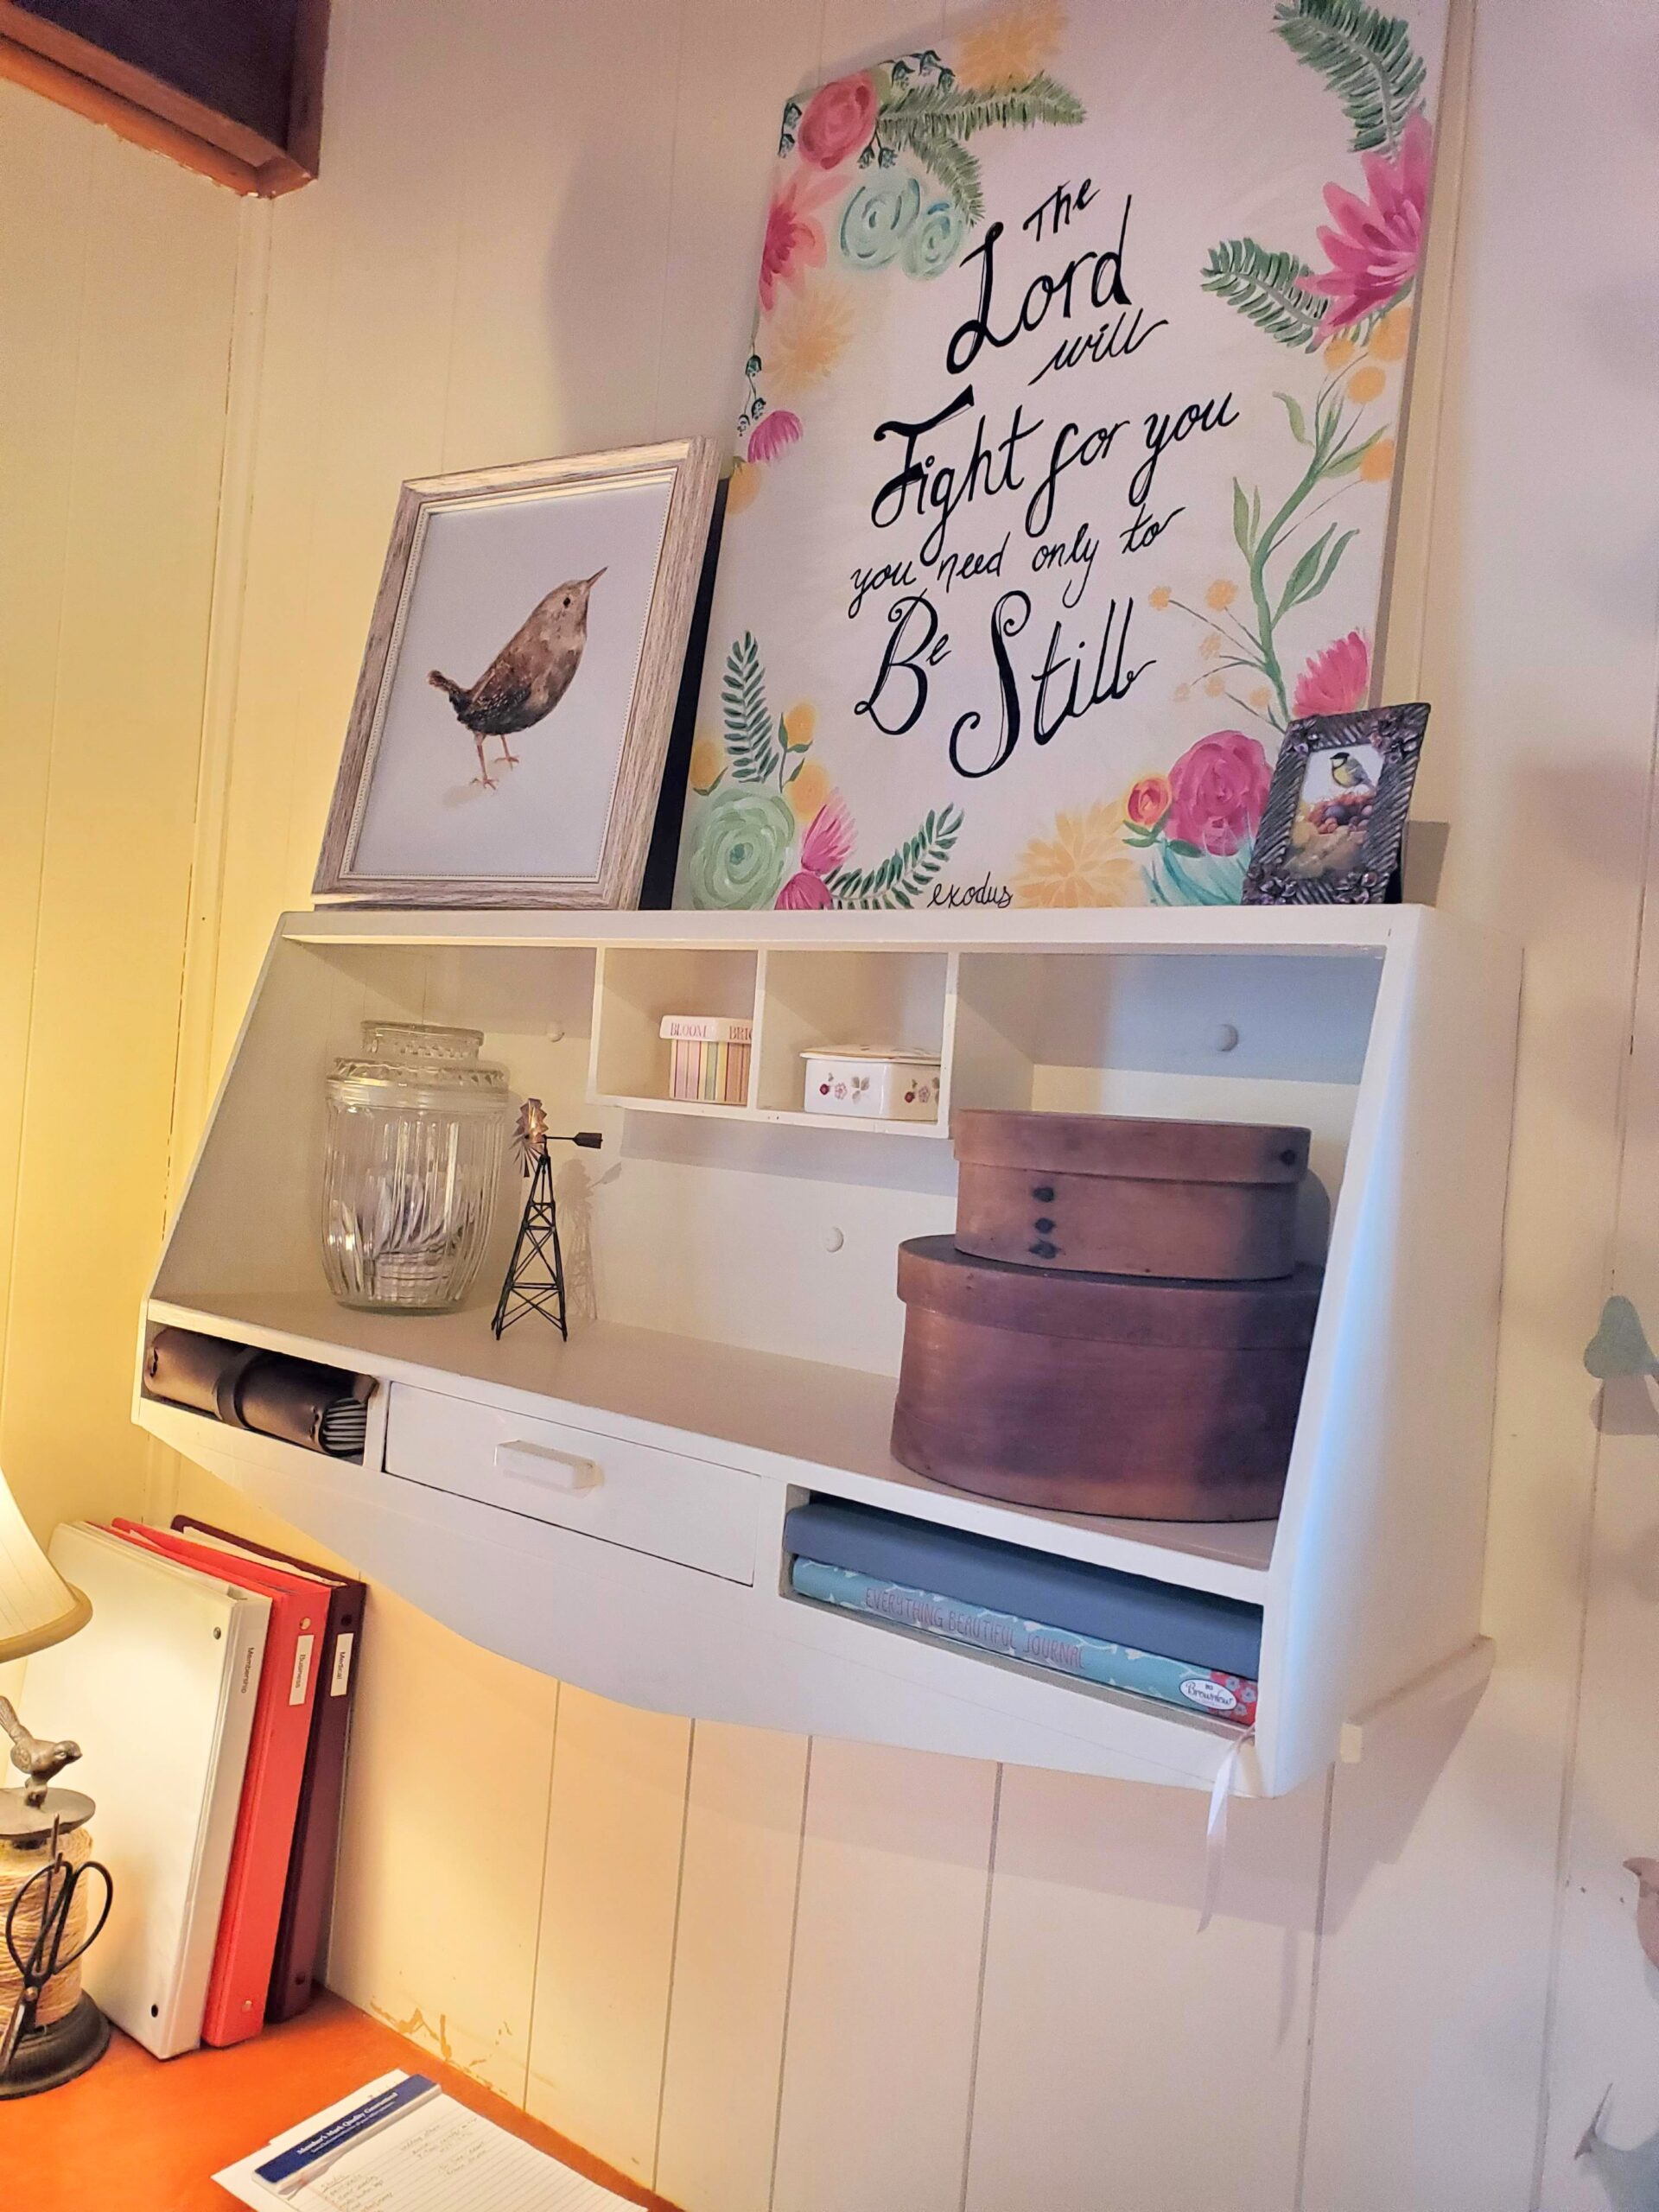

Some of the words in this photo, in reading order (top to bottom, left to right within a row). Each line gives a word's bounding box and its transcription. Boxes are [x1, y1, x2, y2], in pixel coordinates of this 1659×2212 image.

[1022, 178, 1101, 242] The
[946, 194, 1132, 374] Lord
[1027, 308, 1169, 386] will
[870, 384, 1044, 567] Fight
[1025, 422, 1130, 537] for
[1128, 391, 1240, 507] you
[847, 562, 917, 619] you
[936, 531, 1011, 594] need
[1031, 523, 1100, 609] only
[1120, 504, 1186, 554] to
[854, 588, 951, 736] Be
[949, 589, 1157, 779] Still
[926, 871, 1014, 908] exodus
[670, 1022, 708, 1038] BLOOM
[864, 1587, 944, 1628] EVERYTHING
[949, 1611, 1017, 1650] BEAUTIFUL
[1022, 1633, 1086, 1669] JOURNAL
[241, 1647, 255, 1694] Membership
[296, 1654, 306, 1688] Business
[336, 1651, 346, 1679] Medical
